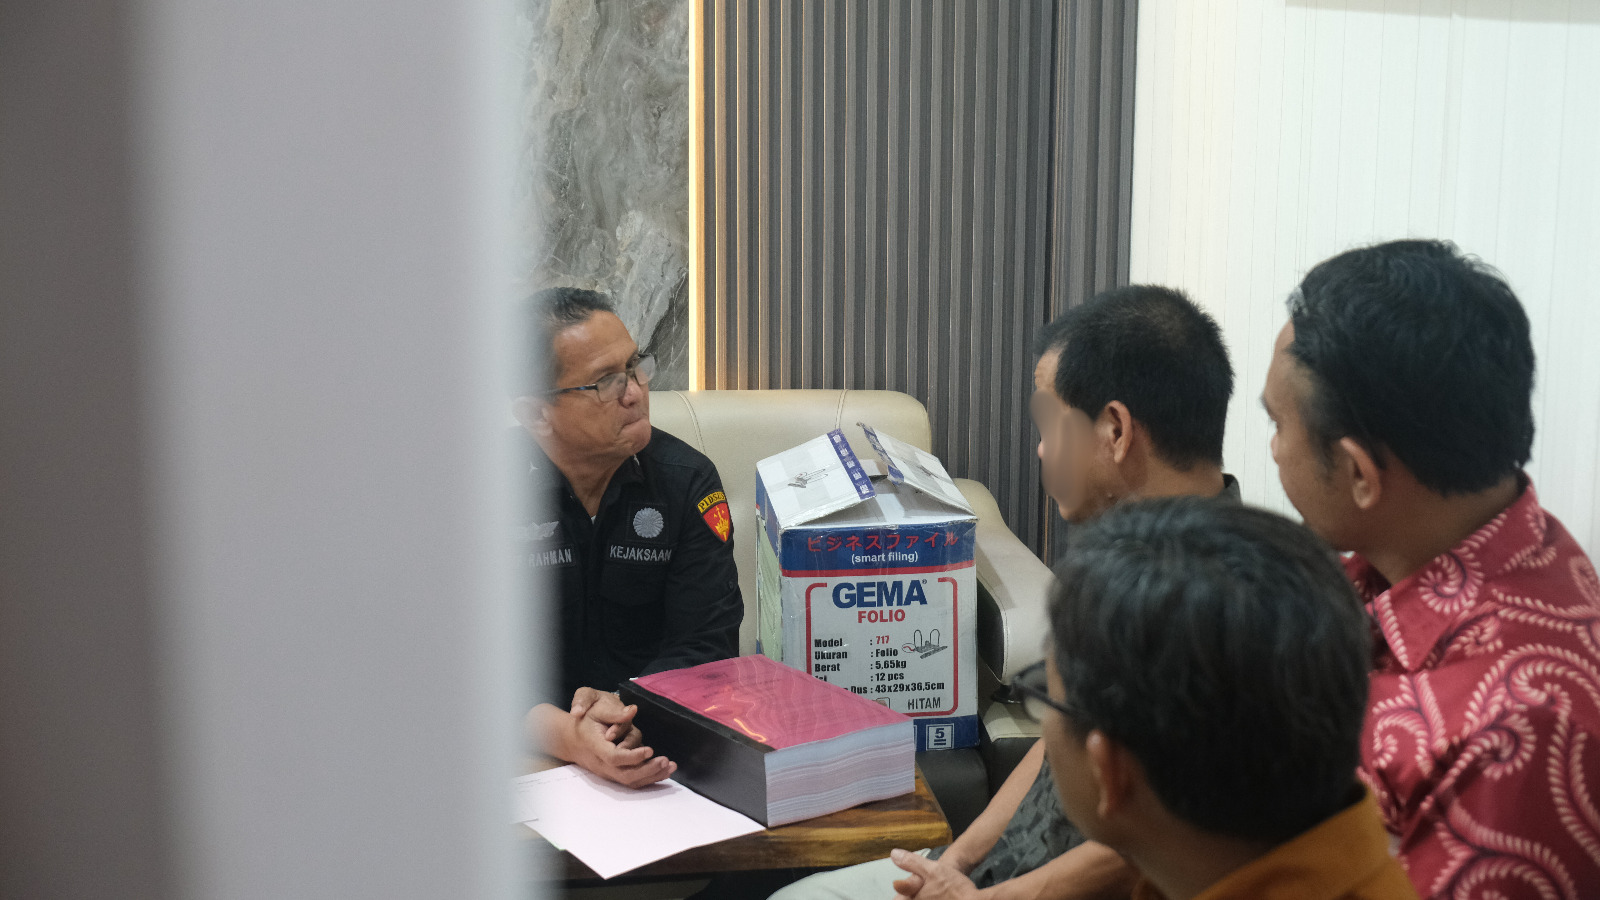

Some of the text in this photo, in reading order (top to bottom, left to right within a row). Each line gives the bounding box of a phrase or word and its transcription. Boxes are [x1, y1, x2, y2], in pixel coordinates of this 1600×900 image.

[807, 531, 959, 552] ビジネスファイル
[609, 544, 672, 562] KEJAKSAAN
[851, 551, 919, 565] (smart filing)
[857, 609, 906, 623] FOLIO
[814, 638, 843, 648] Model
[875, 635, 890, 645] 717
[814, 650, 848, 660] Ukuran
[875, 648, 899, 658] Folio
[814, 663, 841, 672] Berat
[875, 672, 886, 682] 12
[887, 672, 904, 682] pcs
[907, 697, 941, 710] HITAM
[934, 727, 945, 739] 5
